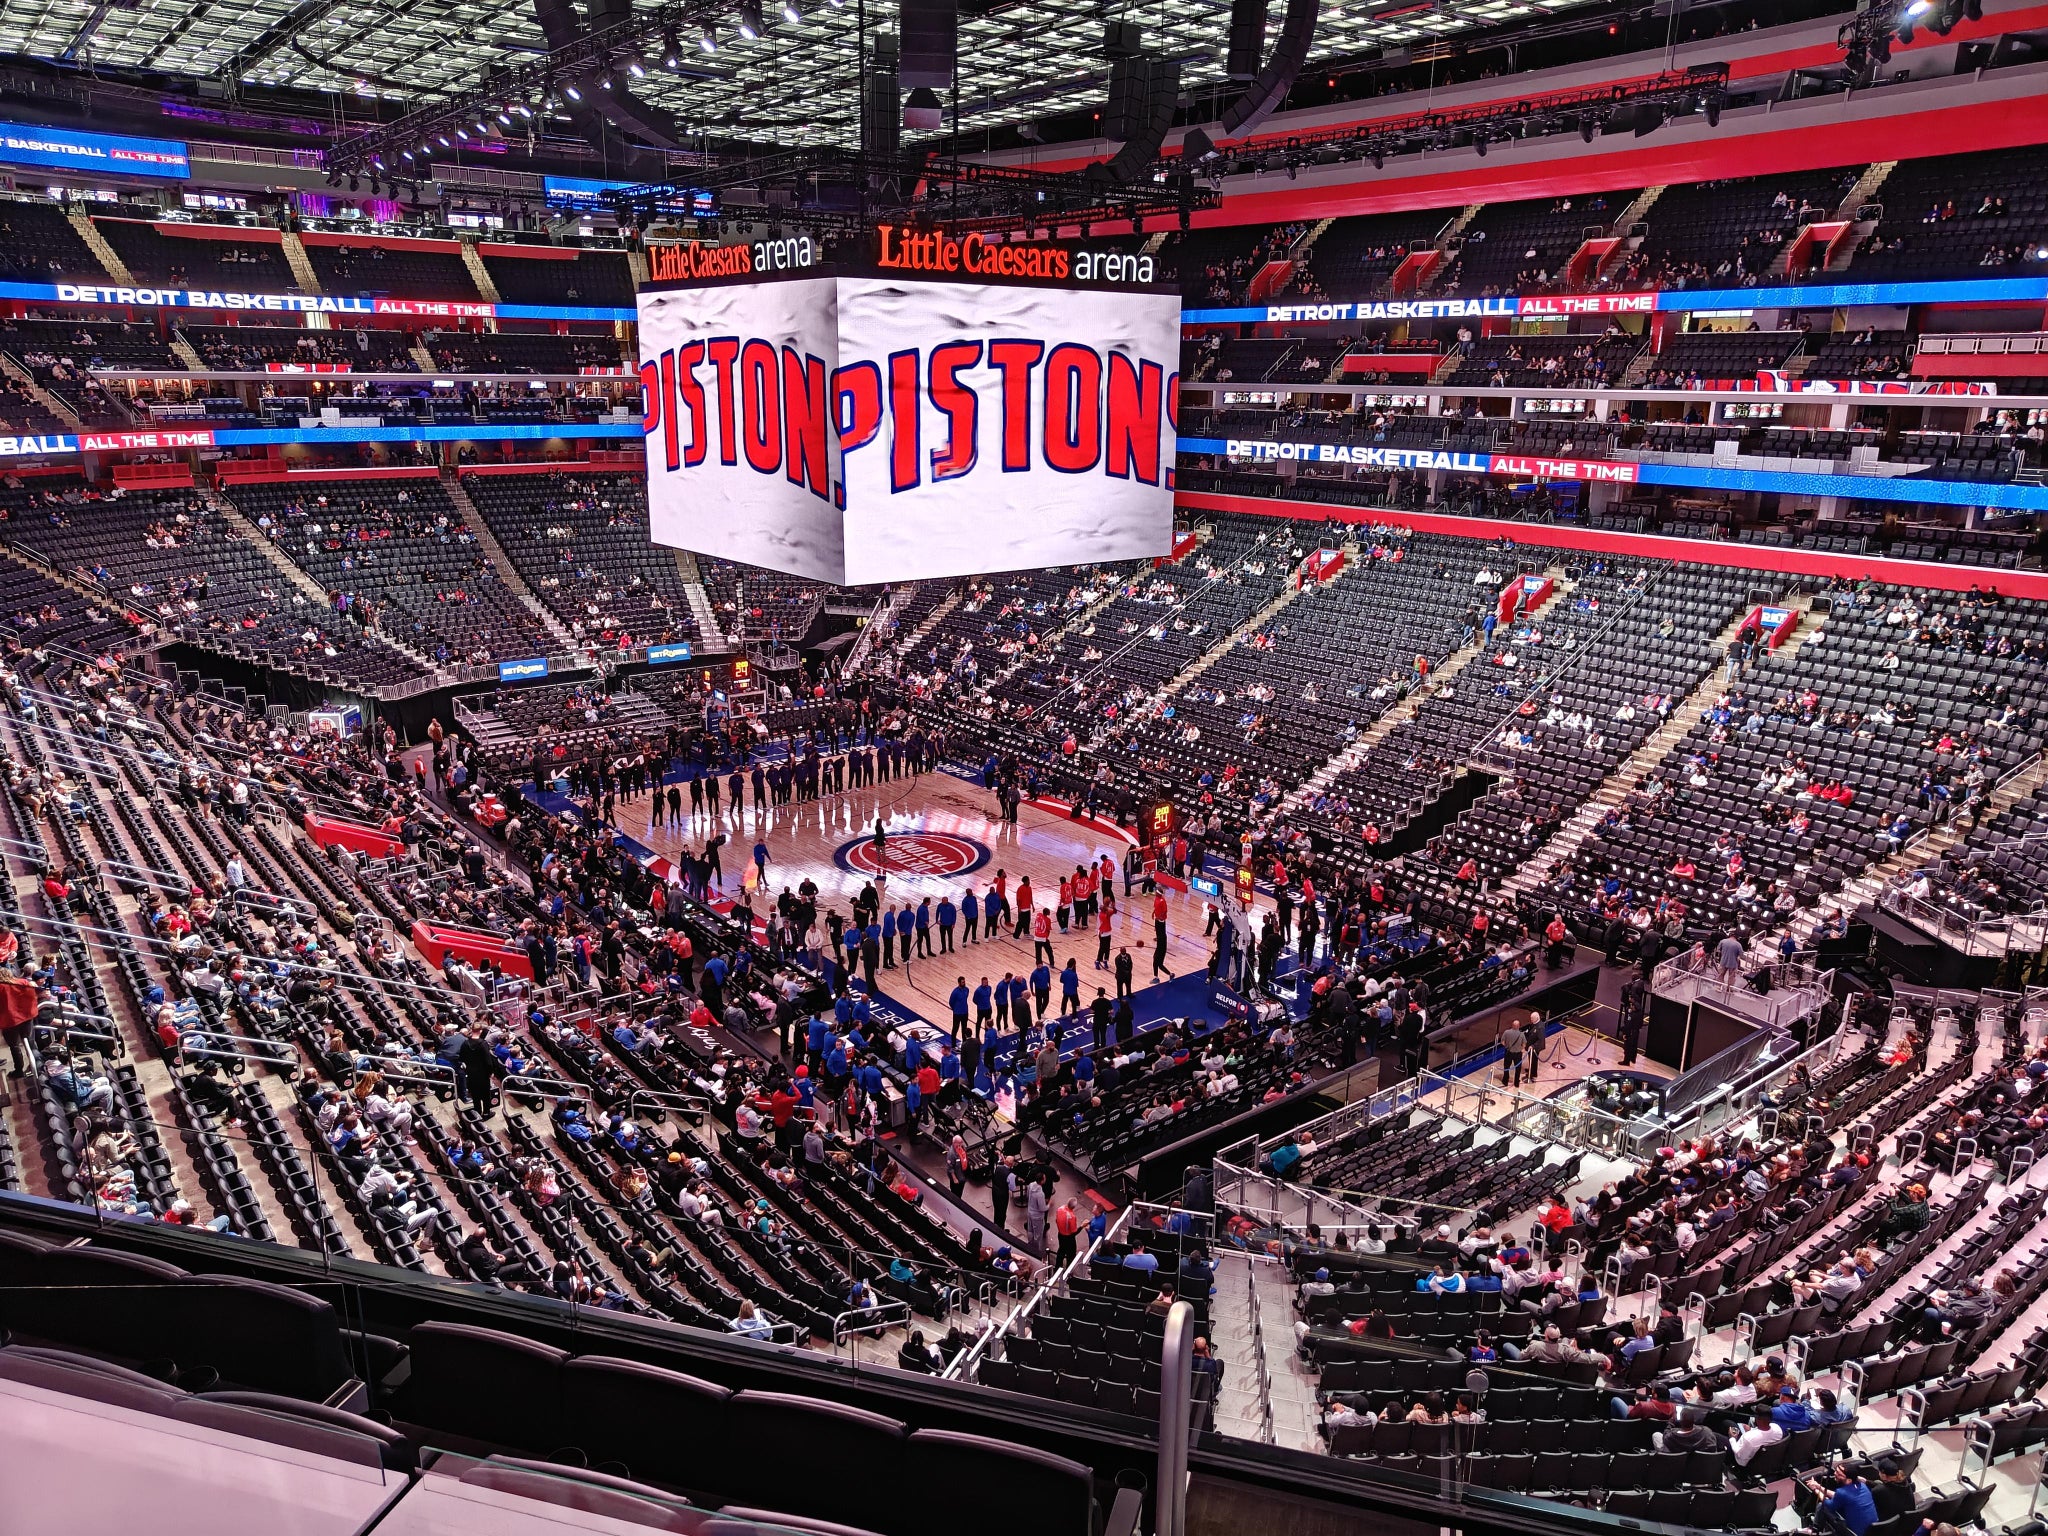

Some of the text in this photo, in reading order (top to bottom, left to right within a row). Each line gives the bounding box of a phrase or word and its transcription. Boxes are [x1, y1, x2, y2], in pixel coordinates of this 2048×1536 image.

[7, 139, 107, 158] BASKETBALL
[114, 151, 135, 160] ALL
[137, 153, 157, 162] THE
[160, 156, 185, 165] TIME
[650, 236, 811, 281] Little Caesars arena
[878, 225, 1154, 283] Little Caesars arena
[57, 285, 492, 317] DETROIT BASKETBALL ALL THE TIME
[1267, 296, 1653, 321] DETROIT BASKETBALL ALL THE TIME
[84, 437, 119, 450] ALL
[121, 434, 157, 447] THE
[163, 433, 211, 446] TIME
[1226, 440, 1634, 481] DETROIT BASKETBALL ALL THE TIME
[735, 667, 748, 678] 24
[1154, 814, 1168, 830] 24
[1215, 992, 1238, 1008] BELFOR
